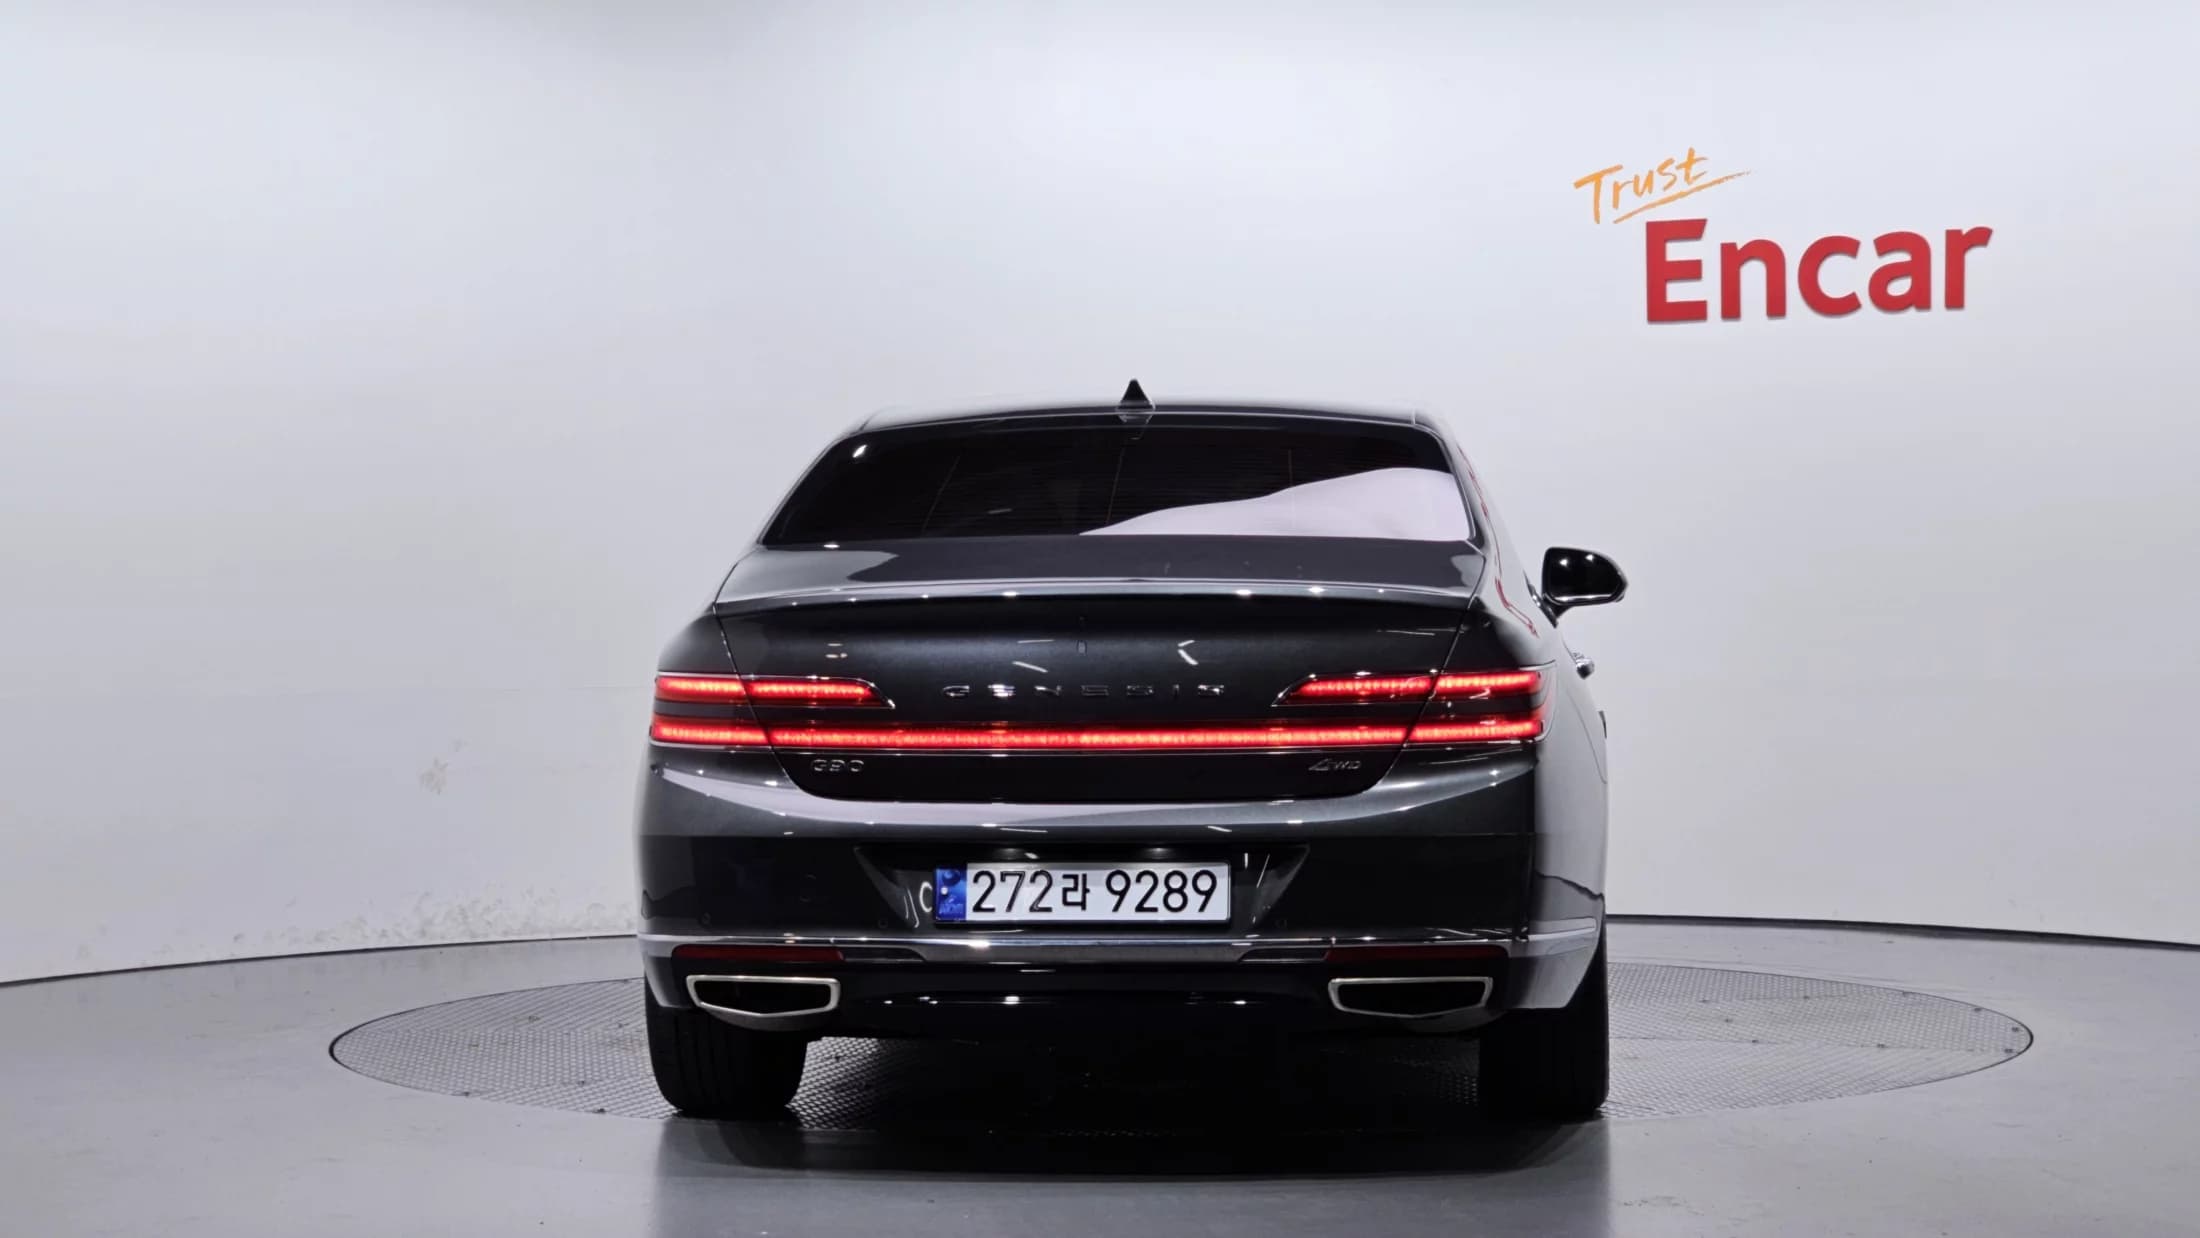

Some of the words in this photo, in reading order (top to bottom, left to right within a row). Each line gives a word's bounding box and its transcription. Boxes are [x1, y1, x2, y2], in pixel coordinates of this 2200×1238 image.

[1573, 147, 1709, 224] Trust
[1645, 218, 1993, 323] Encar
[942, 683, 1225, 698] GENESIS
[811, 758, 865, 773] G90
[971, 869, 1091, 913] 272라
[1104, 869, 1218, 913] 9289
